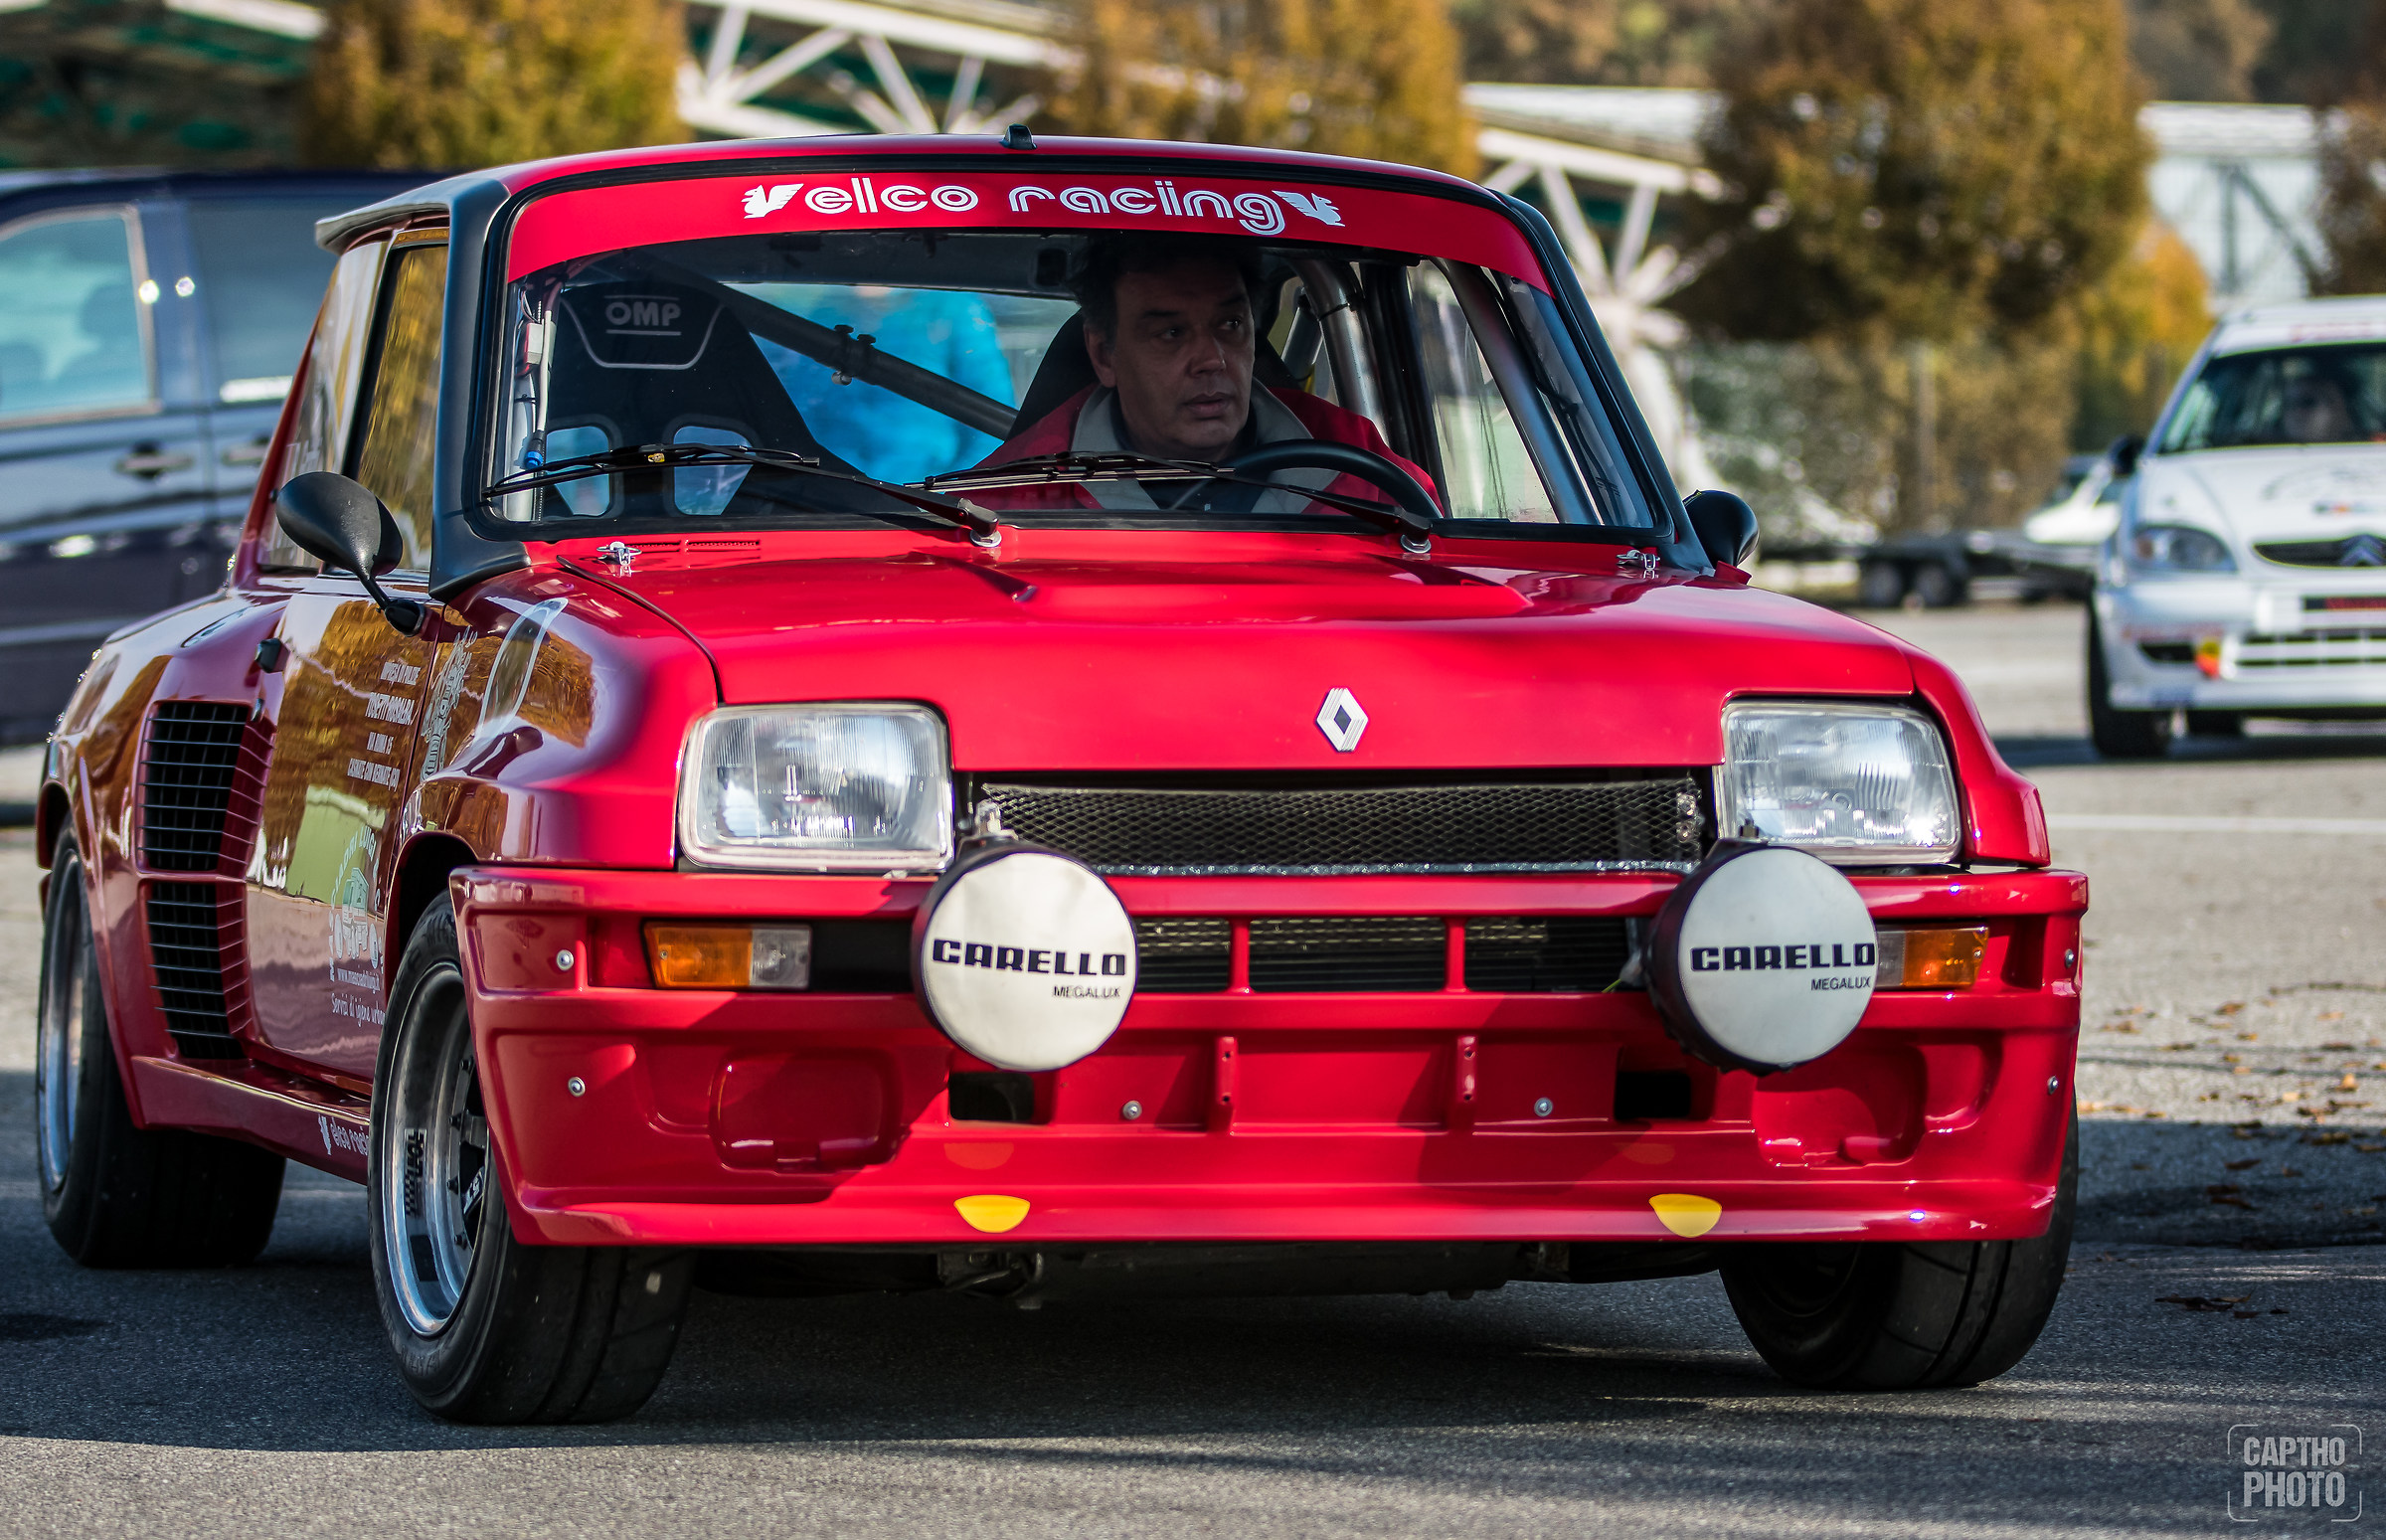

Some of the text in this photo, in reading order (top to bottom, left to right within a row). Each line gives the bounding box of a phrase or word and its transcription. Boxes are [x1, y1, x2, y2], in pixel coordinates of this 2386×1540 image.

[1008, 180, 1285, 236] racing
[605, 301, 681, 326] OMP
[358, 825, 377, 862] LUIGI
[933, 939, 1125, 975] CARELLO
[1690, 942, 1876, 971] CARELLO
[1052, 985, 1120, 998] MEGALUX
[1810, 975, 1872, 991] MEGALUX
